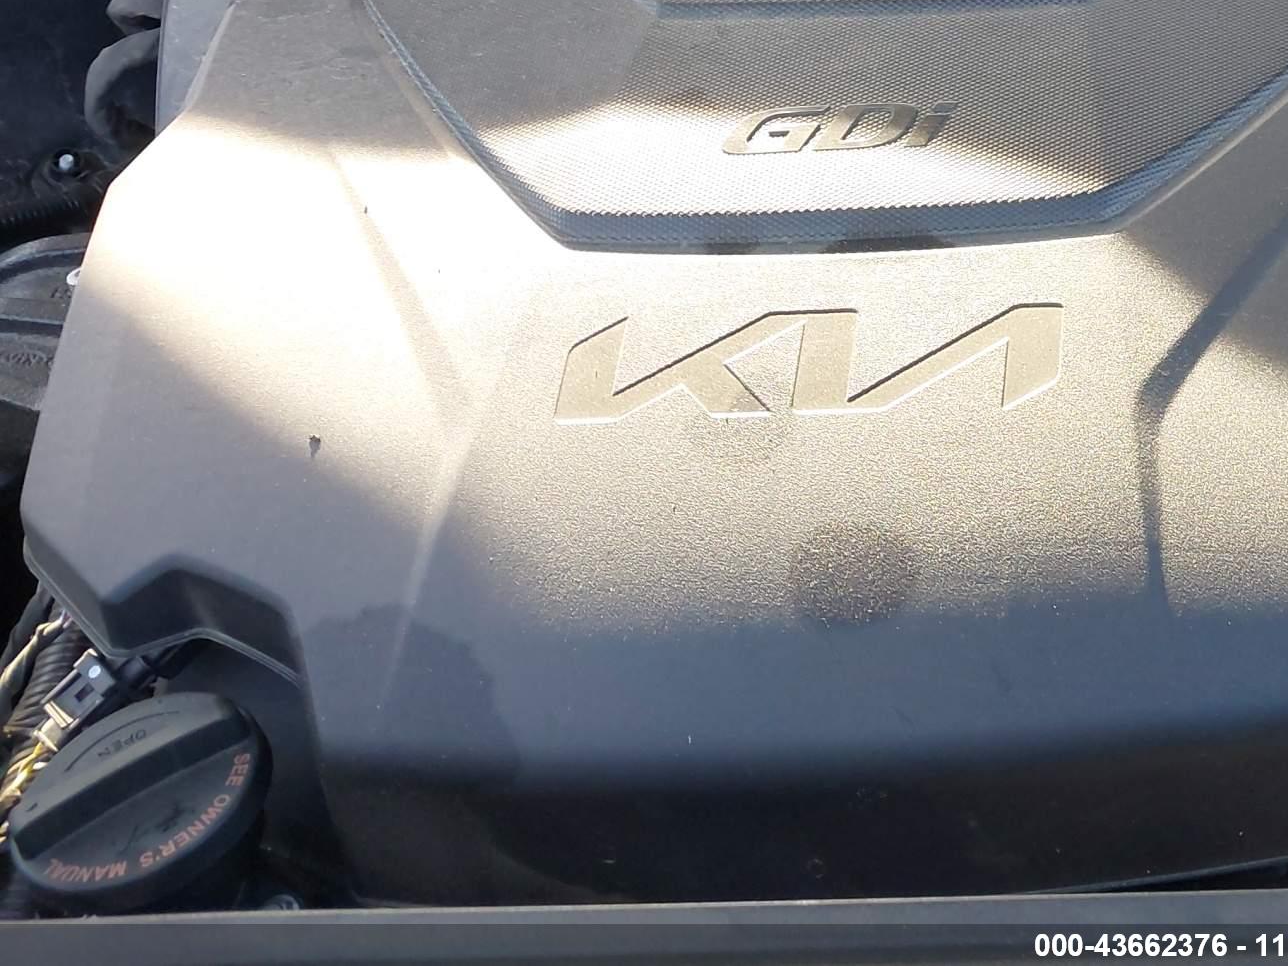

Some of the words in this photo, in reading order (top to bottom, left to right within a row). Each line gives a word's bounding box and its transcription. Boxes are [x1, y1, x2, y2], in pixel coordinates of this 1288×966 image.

[722, 102, 959, 154] GDi
[225, 752, 251, 786] SEE
[139, 794, 231, 867] OWNER'S
[44, 857, 127, 882] MANUAL
